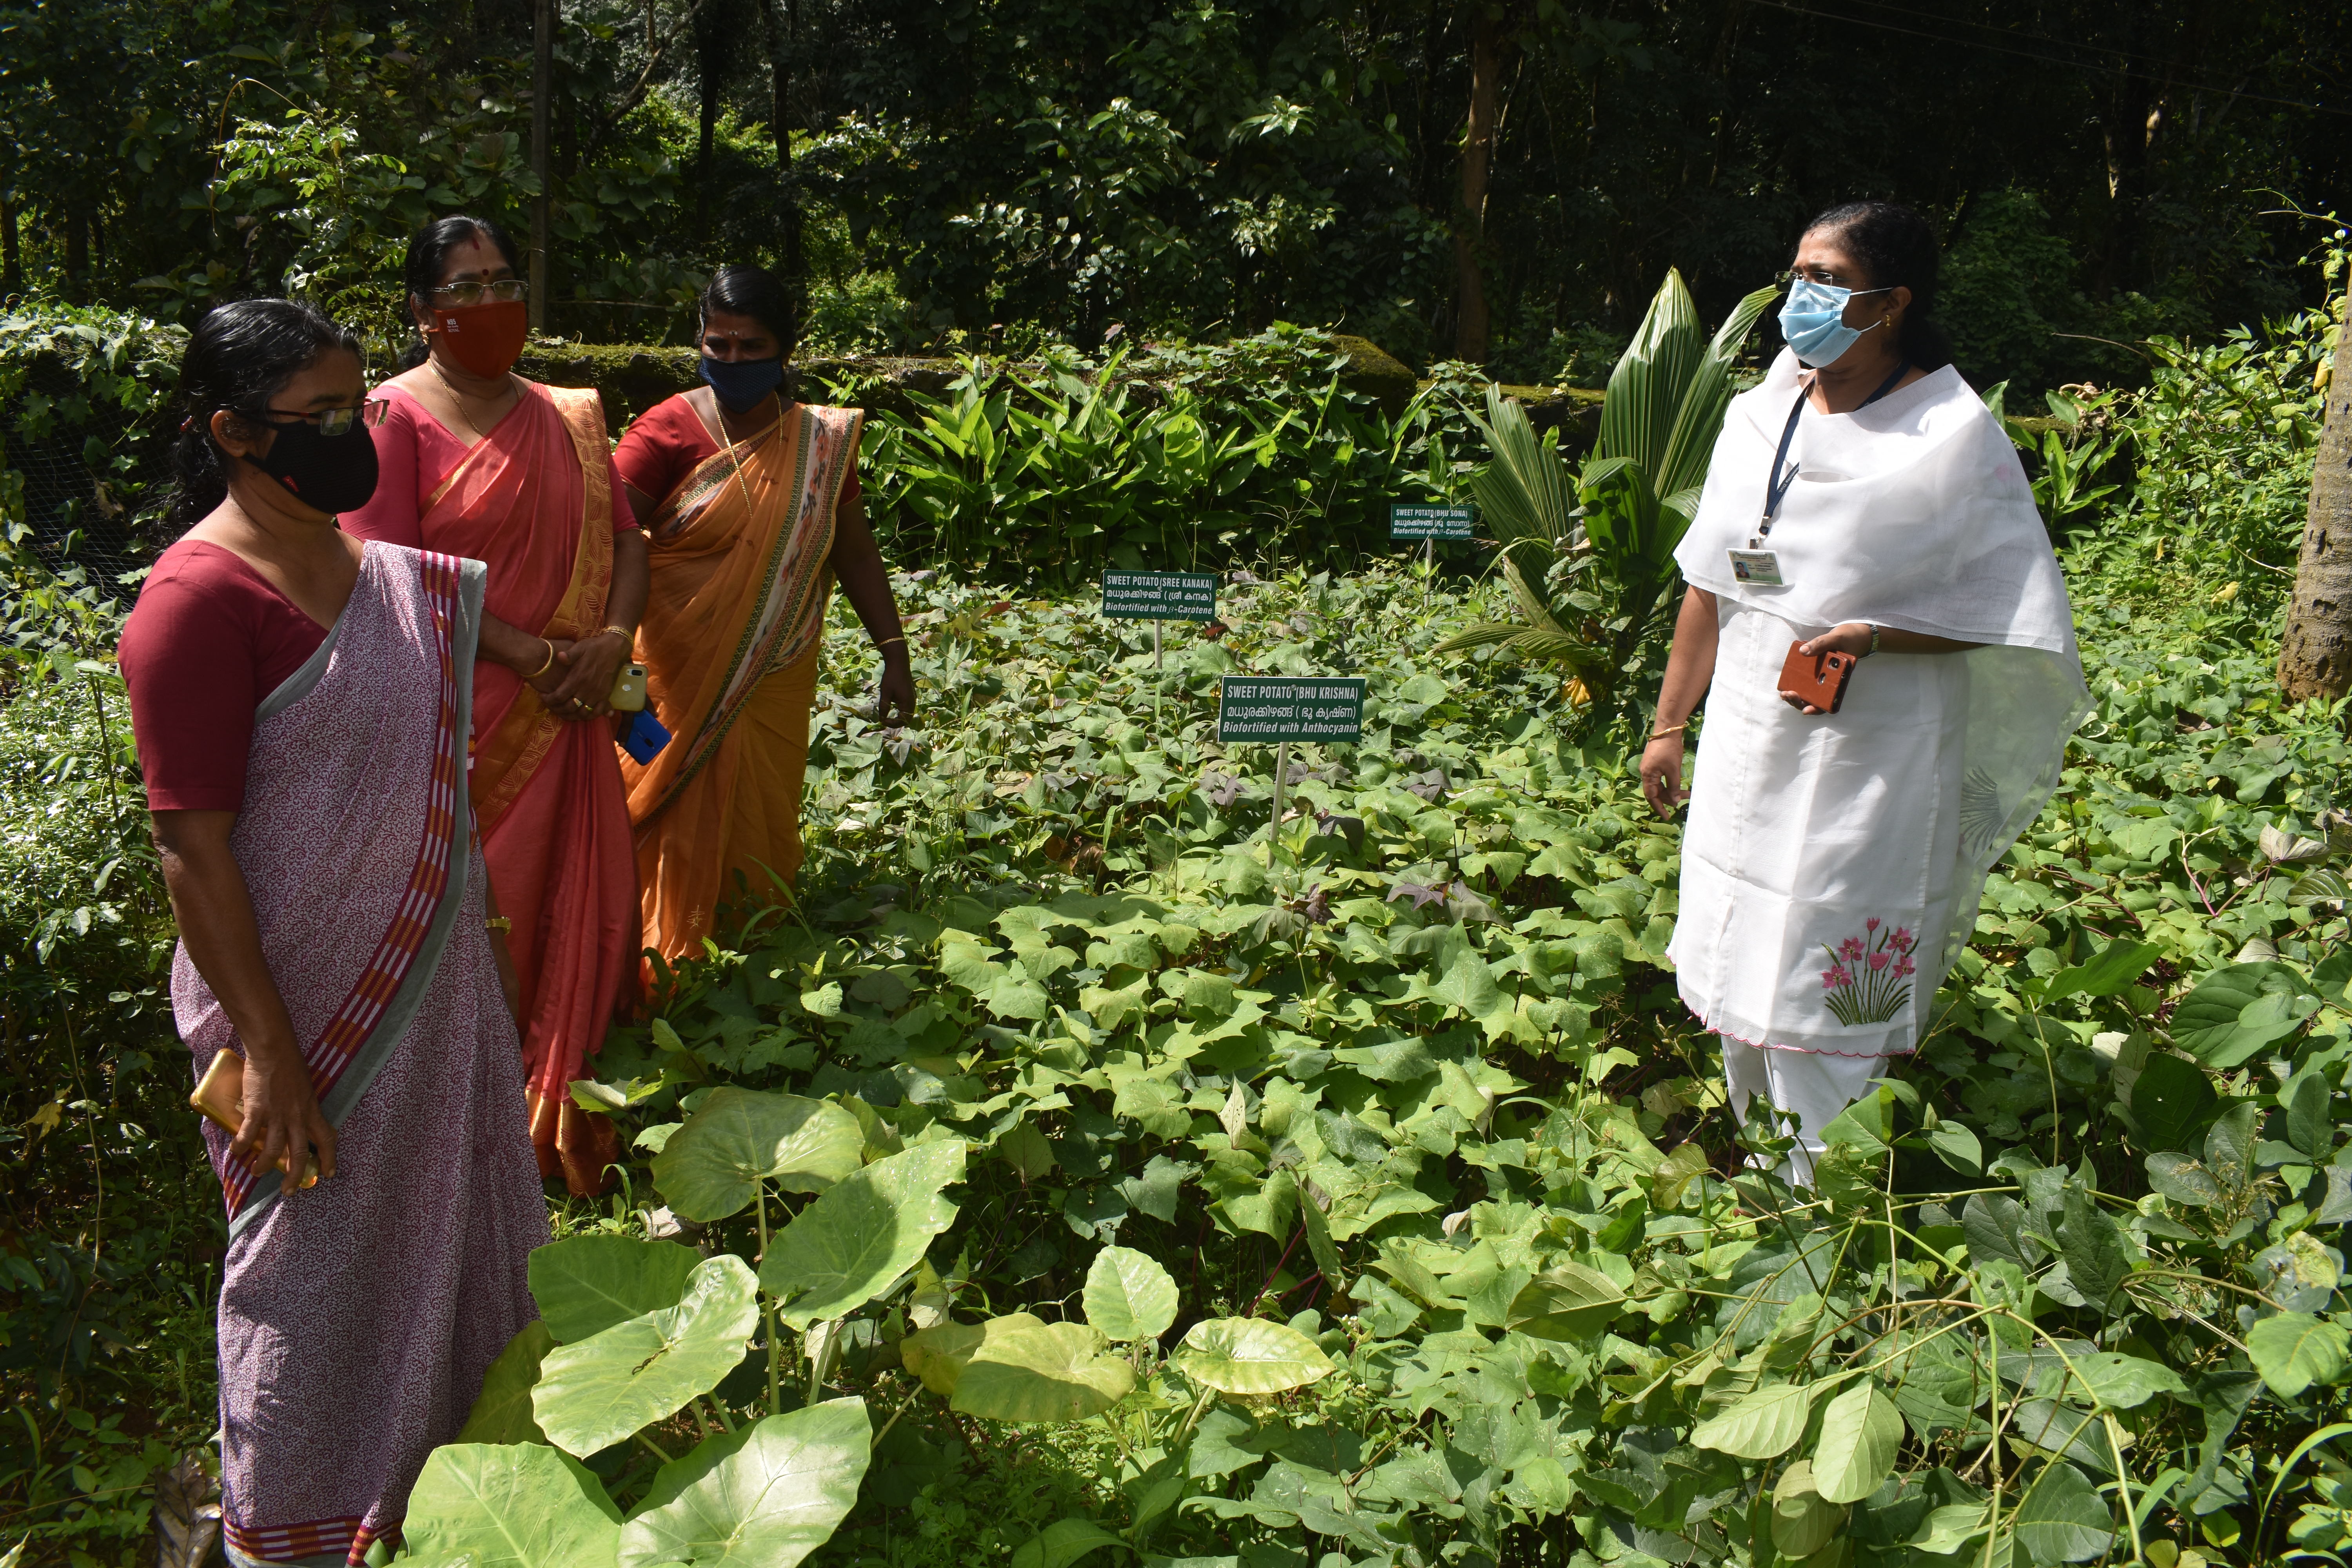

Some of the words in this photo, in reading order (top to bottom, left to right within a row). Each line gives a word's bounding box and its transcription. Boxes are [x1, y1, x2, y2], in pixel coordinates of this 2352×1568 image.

[1450, 510, 1468, 519] SONA)
[1107, 575, 1131, 585] SWEET
[1182, 578, 1212, 591] KANAKA)
[1184, 592, 1212, 602] കനക)
[1105, 602, 1149, 612] Biofortified
[1151, 604, 1167, 612] with
[1227, 685, 1257, 698] SWEET
[1259, 685, 1292, 699] POTATO
[1295, 686, 1316, 701] (BHU
[1319, 687, 1358, 702] KRISHNA)
[1227, 705, 1295, 719] മധുരക്കിഴങ്ങ്
[1223, 721, 1278, 733] Biofortified
[1279, 722, 1299, 733] with
[1301, 722, 1358, 735] Anthocyanin
